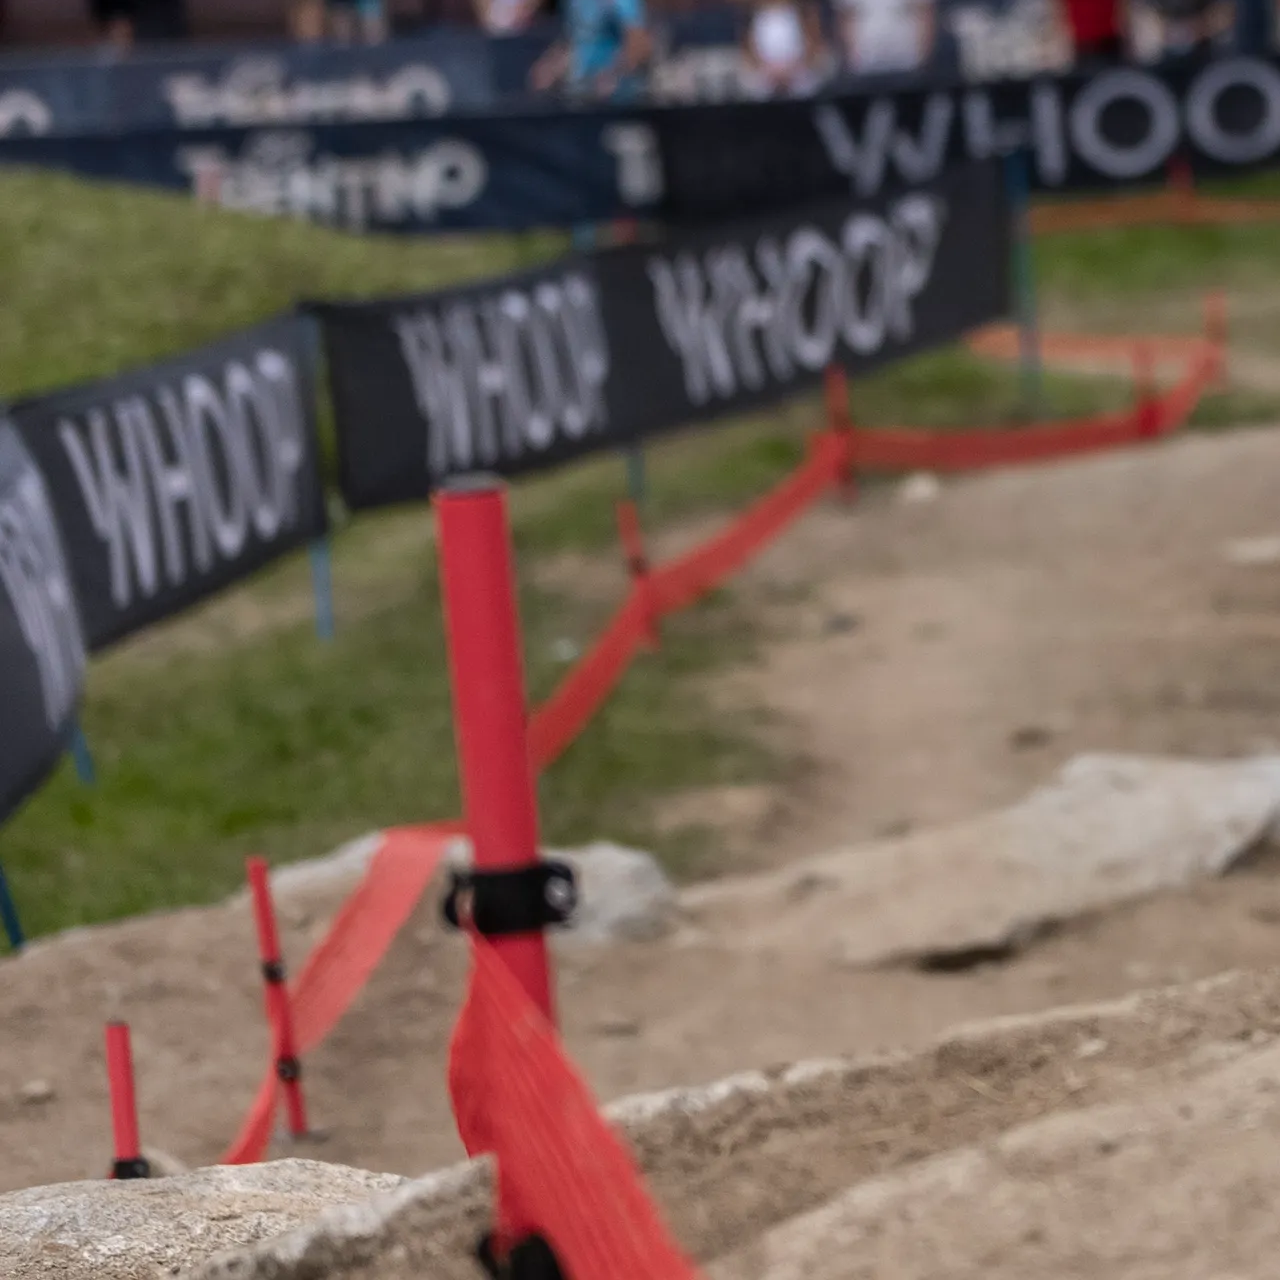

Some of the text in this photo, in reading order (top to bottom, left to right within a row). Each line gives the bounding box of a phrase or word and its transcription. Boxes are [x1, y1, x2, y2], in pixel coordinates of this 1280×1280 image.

[397, 272, 608, 473] WHOOP
[647, 195, 945, 406] WHOOP
[60, 348, 306, 607] WHOOP
